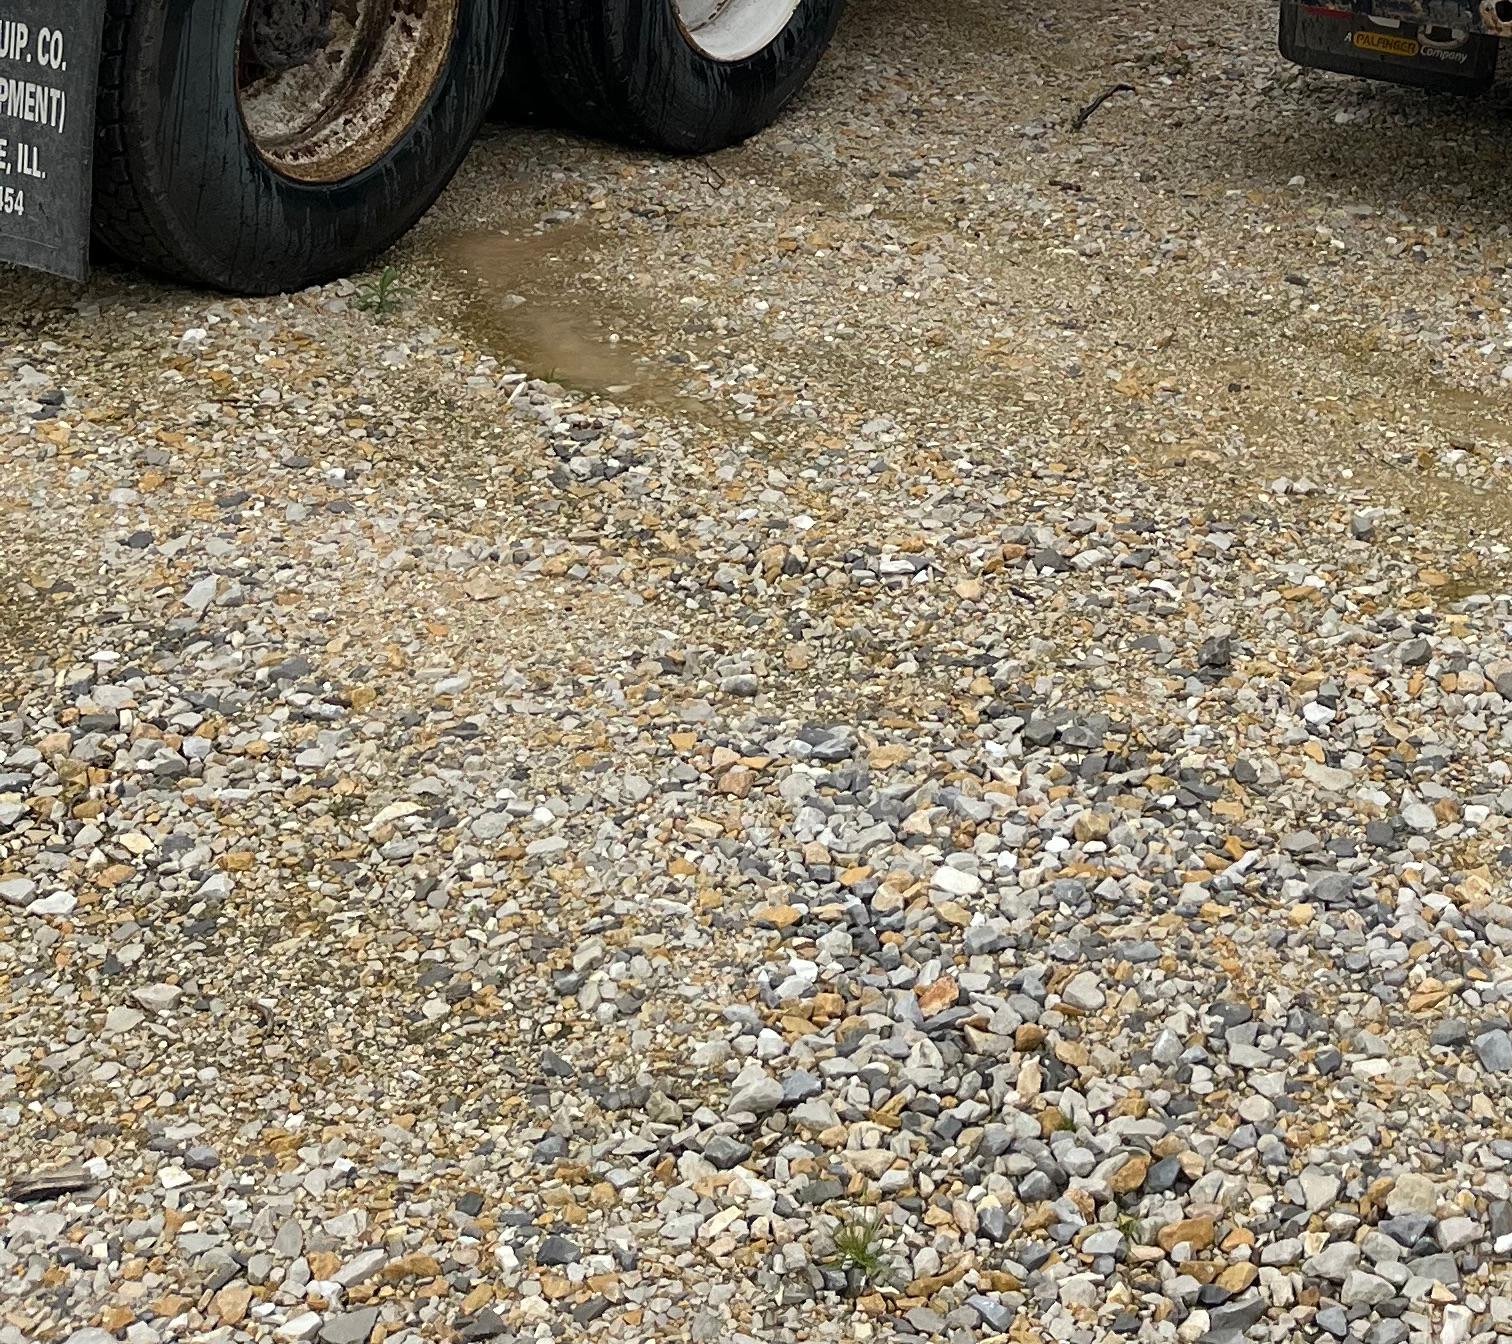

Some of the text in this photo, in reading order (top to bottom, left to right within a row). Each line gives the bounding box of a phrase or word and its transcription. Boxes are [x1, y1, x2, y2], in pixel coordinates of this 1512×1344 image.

[37, 27, 67, 71] CO.
[1344, 32, 1468, 64] A PALFINGER Company
[17, 143, 46, 179] ILL.
